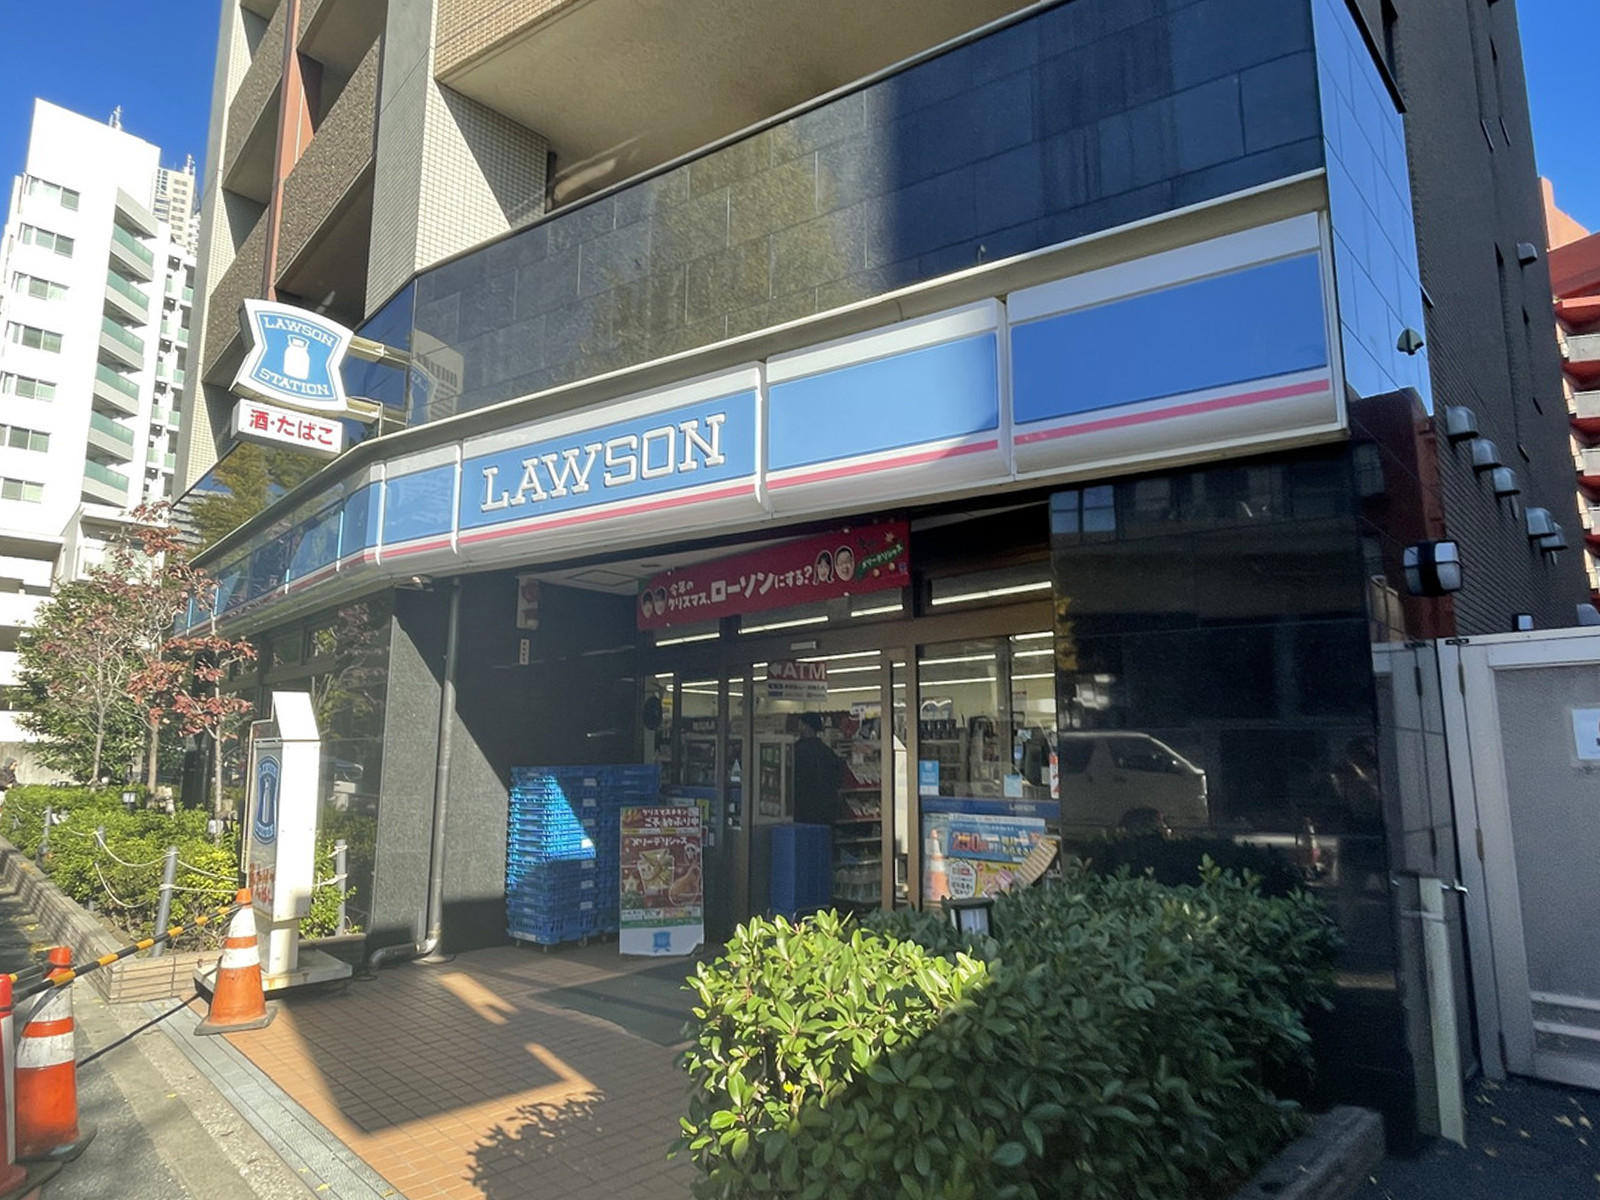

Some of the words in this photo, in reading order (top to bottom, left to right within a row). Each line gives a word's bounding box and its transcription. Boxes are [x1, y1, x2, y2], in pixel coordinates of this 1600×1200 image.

[263, 316, 335, 347] LAWSON
[259, 367, 330, 395] STATION
[249, 409, 333, 445] 酒・たばこ
[482, 413, 725, 511] LAWSON
[782, 662, 826, 680] ATM
